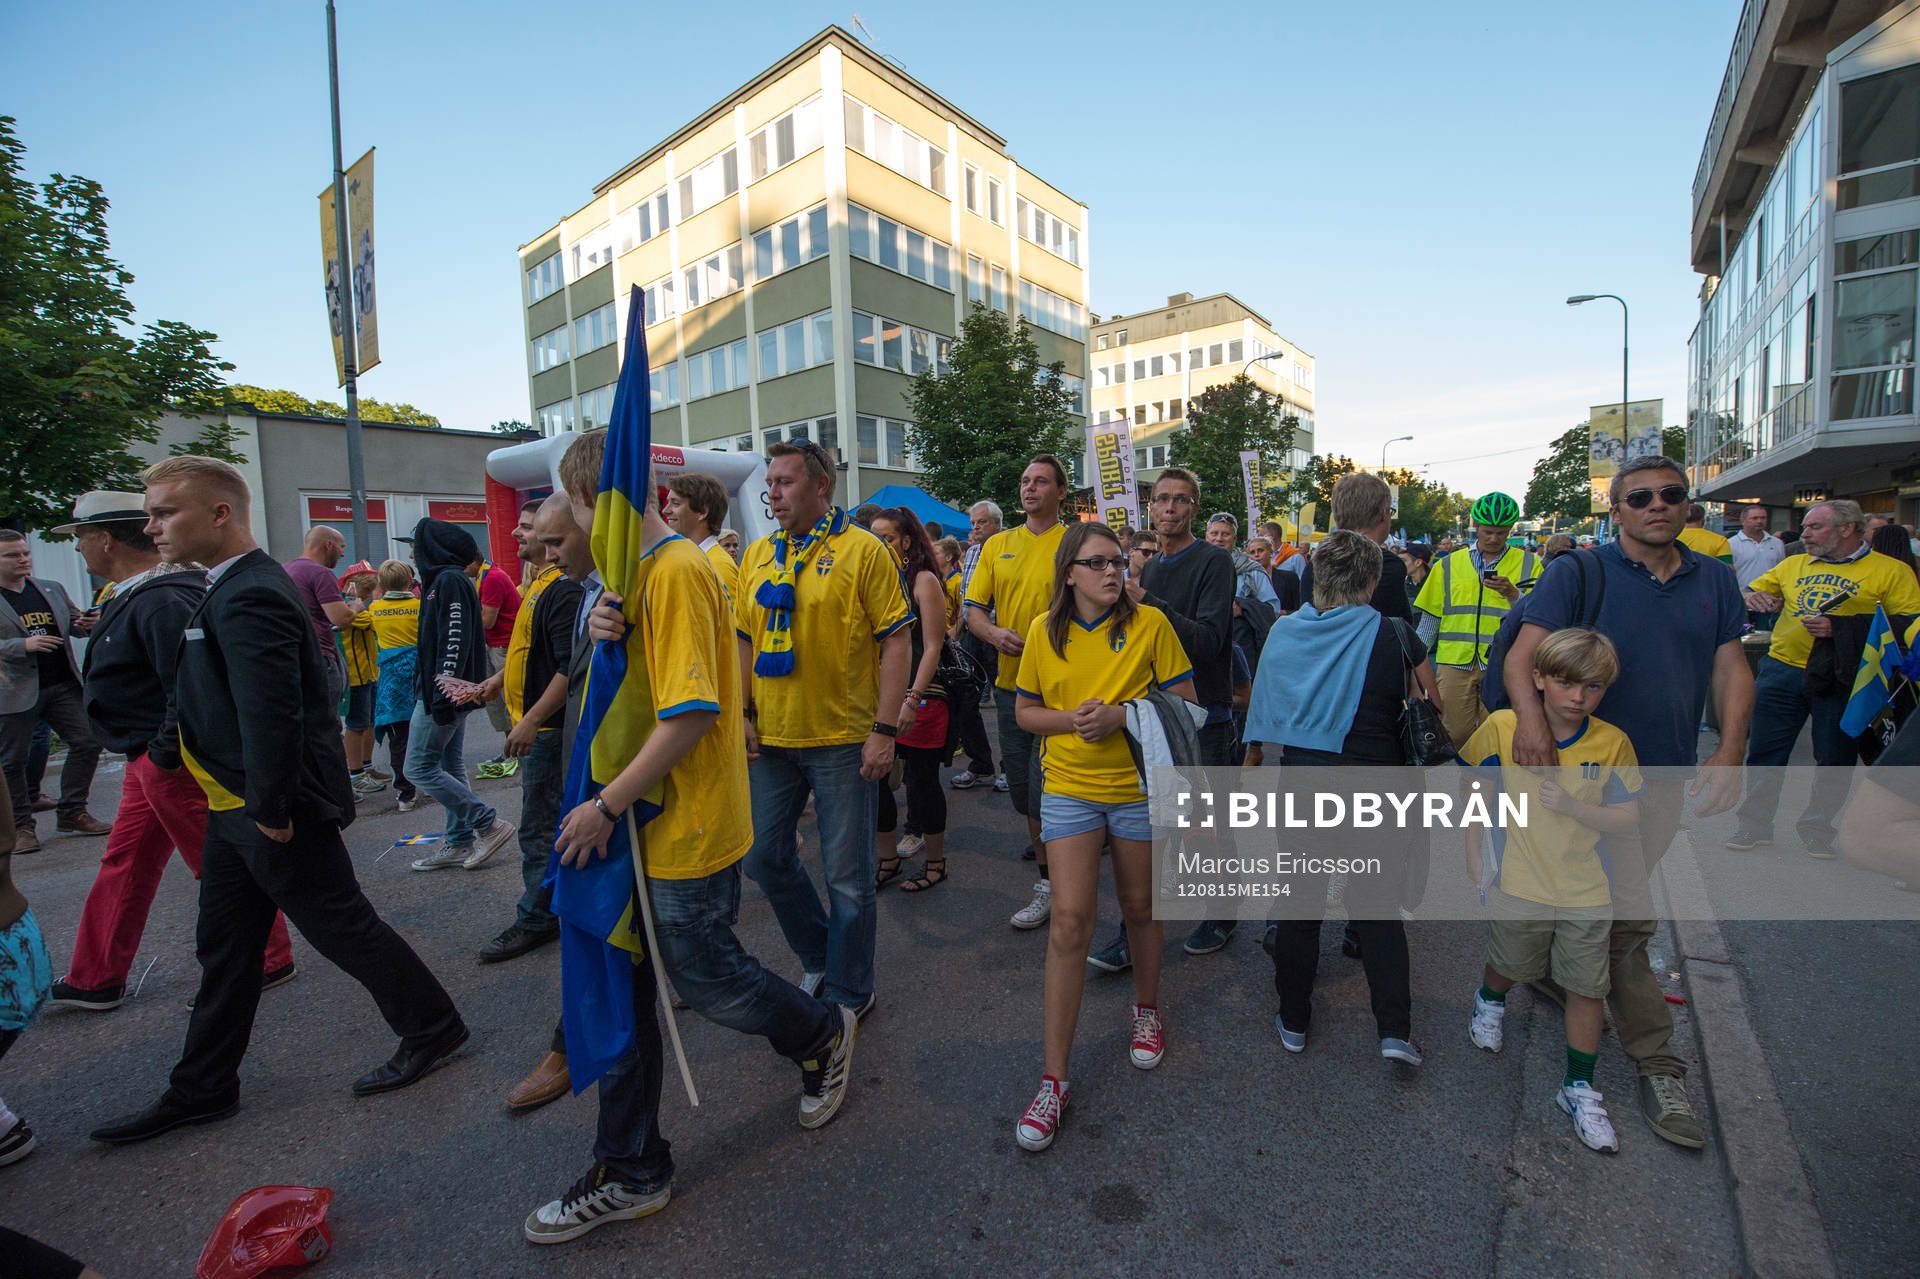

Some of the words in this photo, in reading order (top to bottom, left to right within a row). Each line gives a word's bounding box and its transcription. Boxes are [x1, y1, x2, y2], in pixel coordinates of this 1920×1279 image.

[651, 452, 683, 464] Adecco
[1797, 488, 1824, 502] 102
[443, 602, 462, 678] HOLLISTER
[1580, 761, 1600, 780] 10
